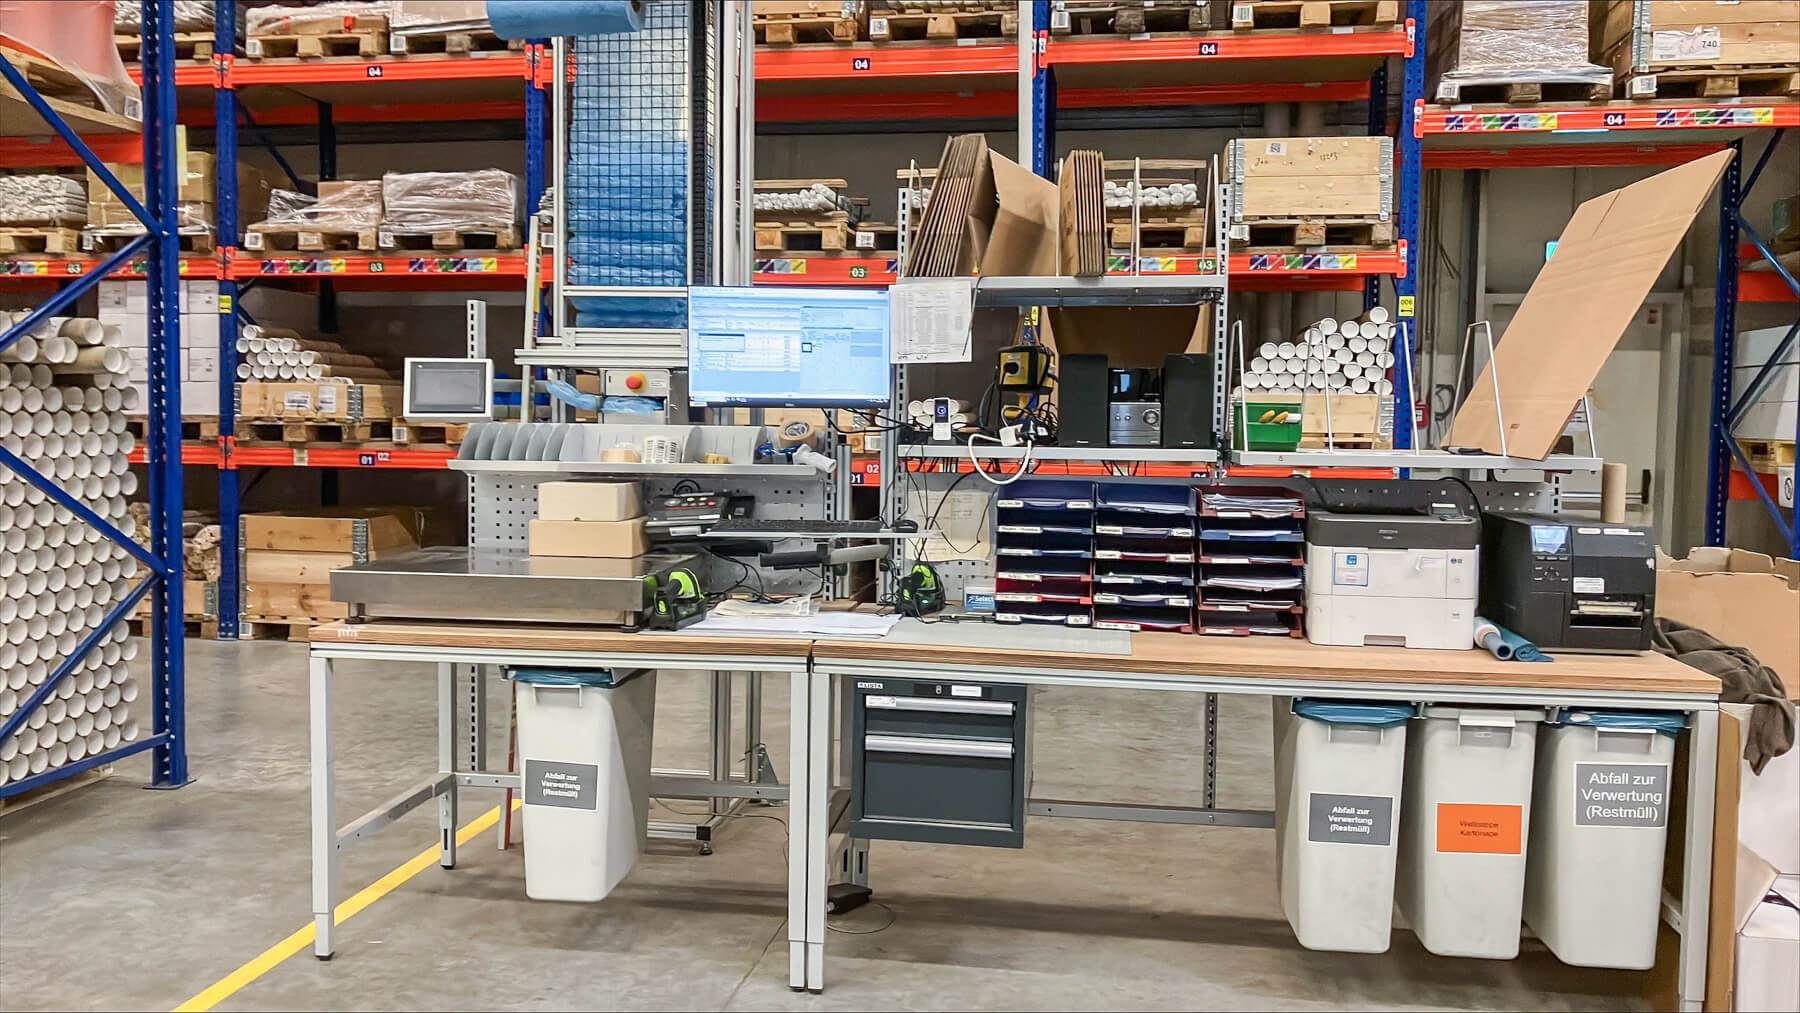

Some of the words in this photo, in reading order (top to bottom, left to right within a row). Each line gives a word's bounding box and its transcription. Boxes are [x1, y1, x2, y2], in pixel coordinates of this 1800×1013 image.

[1201, 43, 1216, 55] 04
[854, 59, 868, 70] 04
[1606, 114, 1623, 126] 04
[67, 262, 82, 275] 03
[369, 262, 383, 273] 03
[850, 266, 865, 278] 03
[360, 455, 373, 465] 01
[866, 463, 880, 474] 02
[1588, 771, 1630, 785] Abfall
[1632, 775, 1657, 785] zur
[1581, 788, 1663, 805] Verwertung
[1332, 805, 1356, 815] Abfall
[1585, 805, 1658, 822] (Restmüll)
[1328, 814, 1374, 826] Verwertung
[1330, 823, 1371, 835] (Restmüll)
